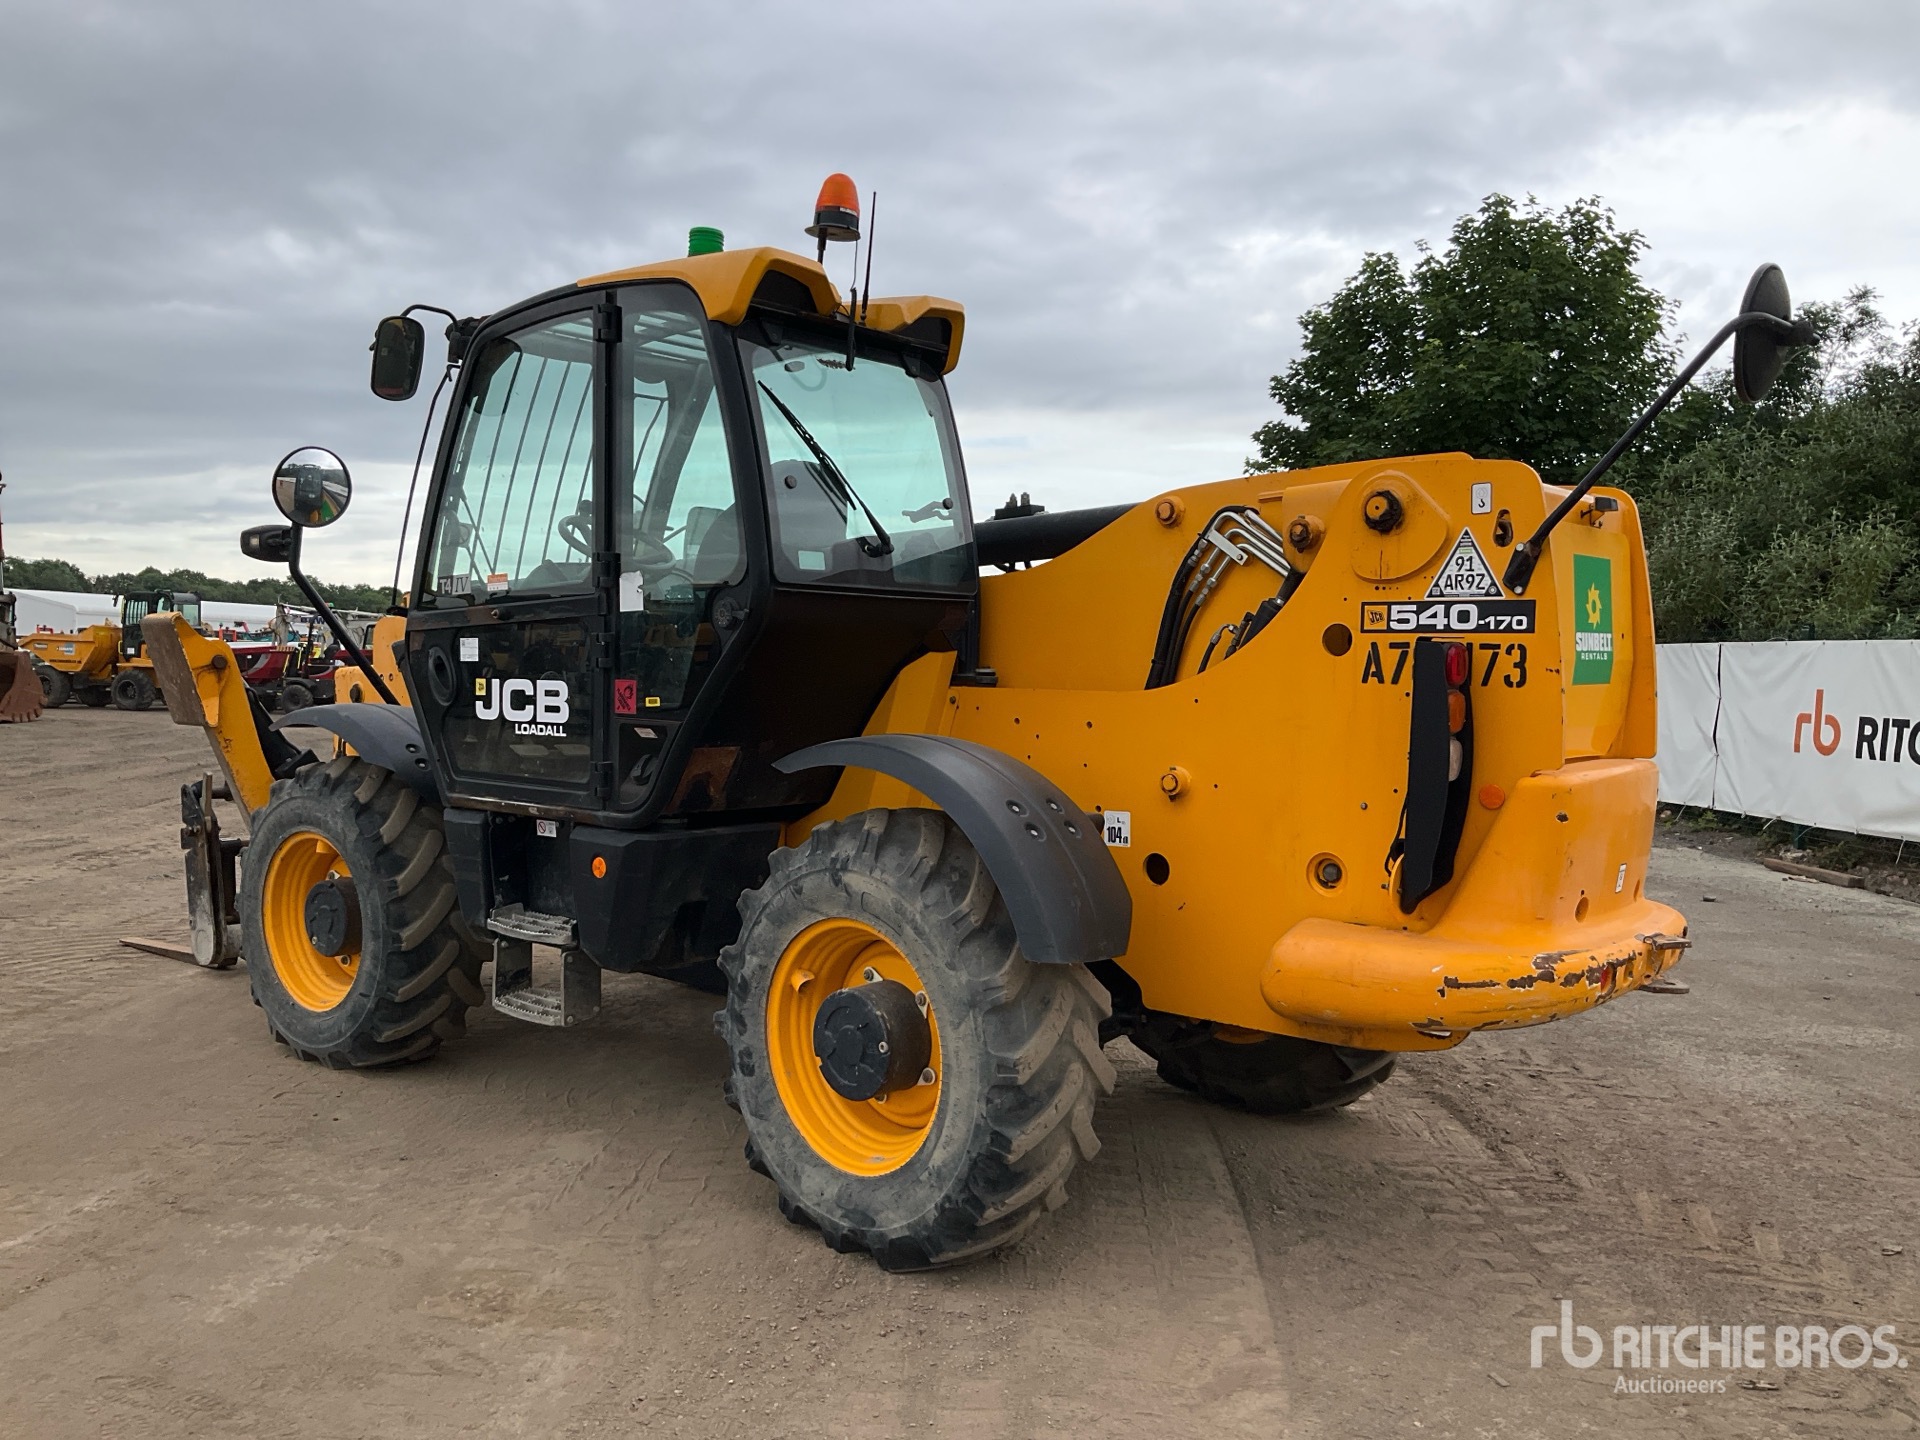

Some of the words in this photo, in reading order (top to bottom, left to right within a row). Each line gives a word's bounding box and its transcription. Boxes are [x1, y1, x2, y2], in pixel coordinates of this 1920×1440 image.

[1455, 555, 1475, 573] 91
[1443, 573, 1486, 591] AR9Z
[1369, 610, 1384, 623] JCB
[1390, 604, 1528, 630] 540-170
[1576, 632, 1612, 651] SUNBELT
[1581, 652, 1608, 660] RENTALS
[475, 678, 570, 724] JCB
[515, 724, 567, 737] LOADALL
[1106, 826, 1122, 844] 104
